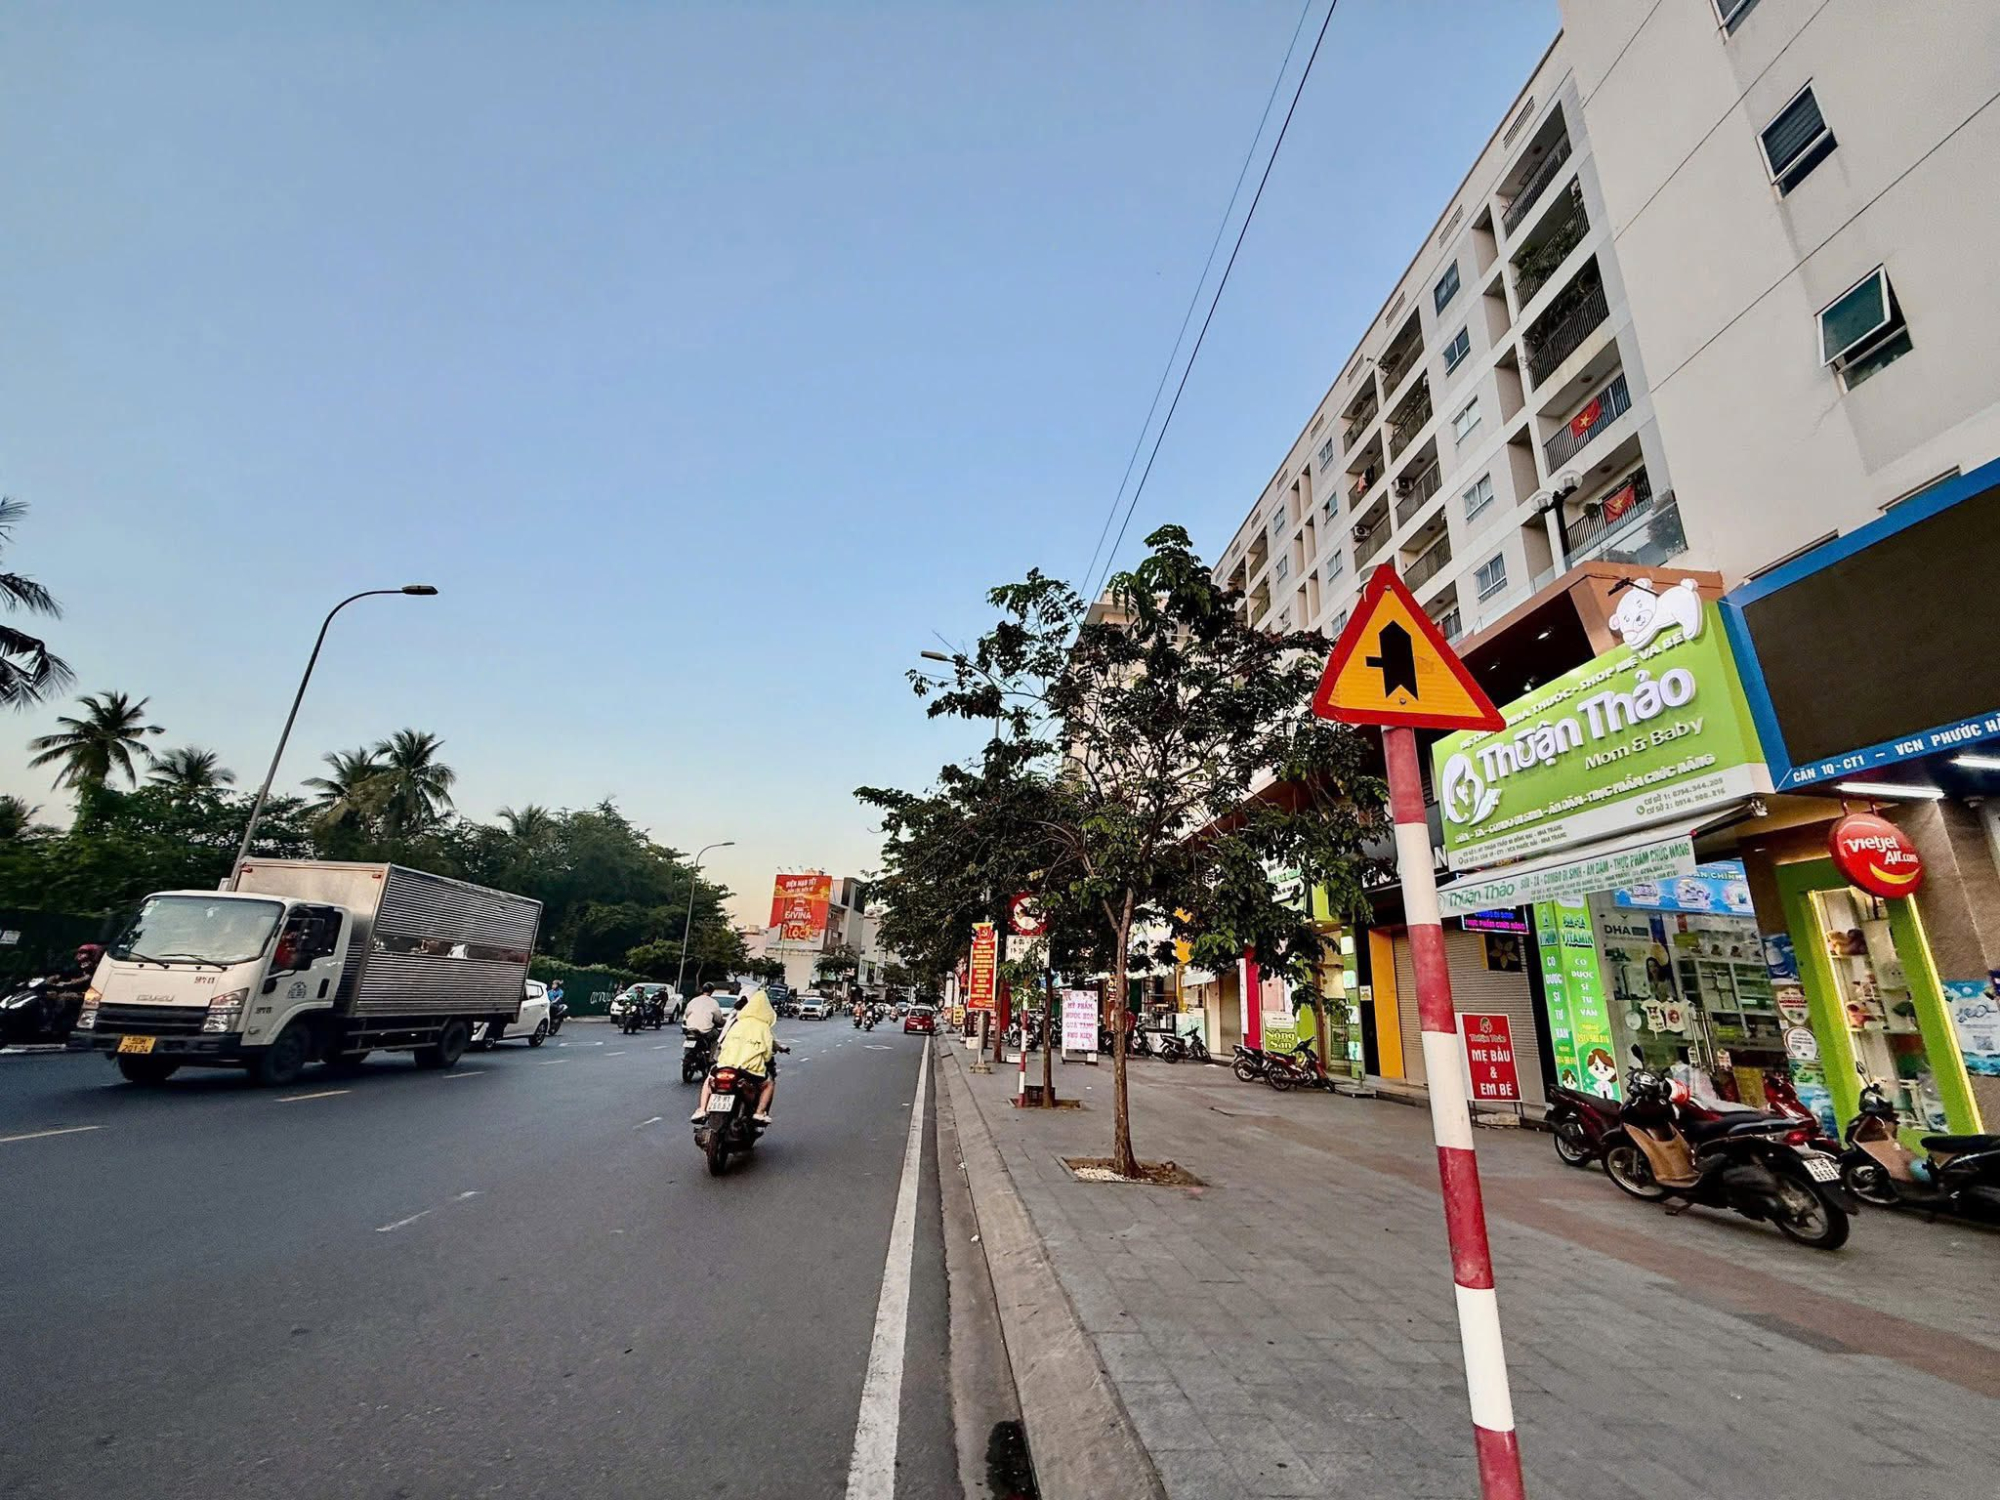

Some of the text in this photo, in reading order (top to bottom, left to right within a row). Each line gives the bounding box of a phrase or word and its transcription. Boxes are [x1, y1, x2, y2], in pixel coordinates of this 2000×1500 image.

[1579, 666, 1616, 690] SHOP
[1577, 668, 1696, 741] Thảo
[1585, 715, 1704, 771] Mom & Baby
[1793, 768, 1816, 783] CĂN
[1894, 739, 1925, 756] VCN
[1930, 722, 1982, 747] PHƯỚC
[1676, 753, 1716, 775] NĂNG
[1843, 835, 1899, 853] vietjet
[1484, 881, 1515, 900] Thảo
[1603, 924, 1632, 935] DHA
[1265, 1029, 1295, 1041] Nông
[1471, 1049, 1488, 1064] MẸ
[1489, 1066, 1498, 1079] &
[1480, 1081, 1513, 1097] EM BÉ
